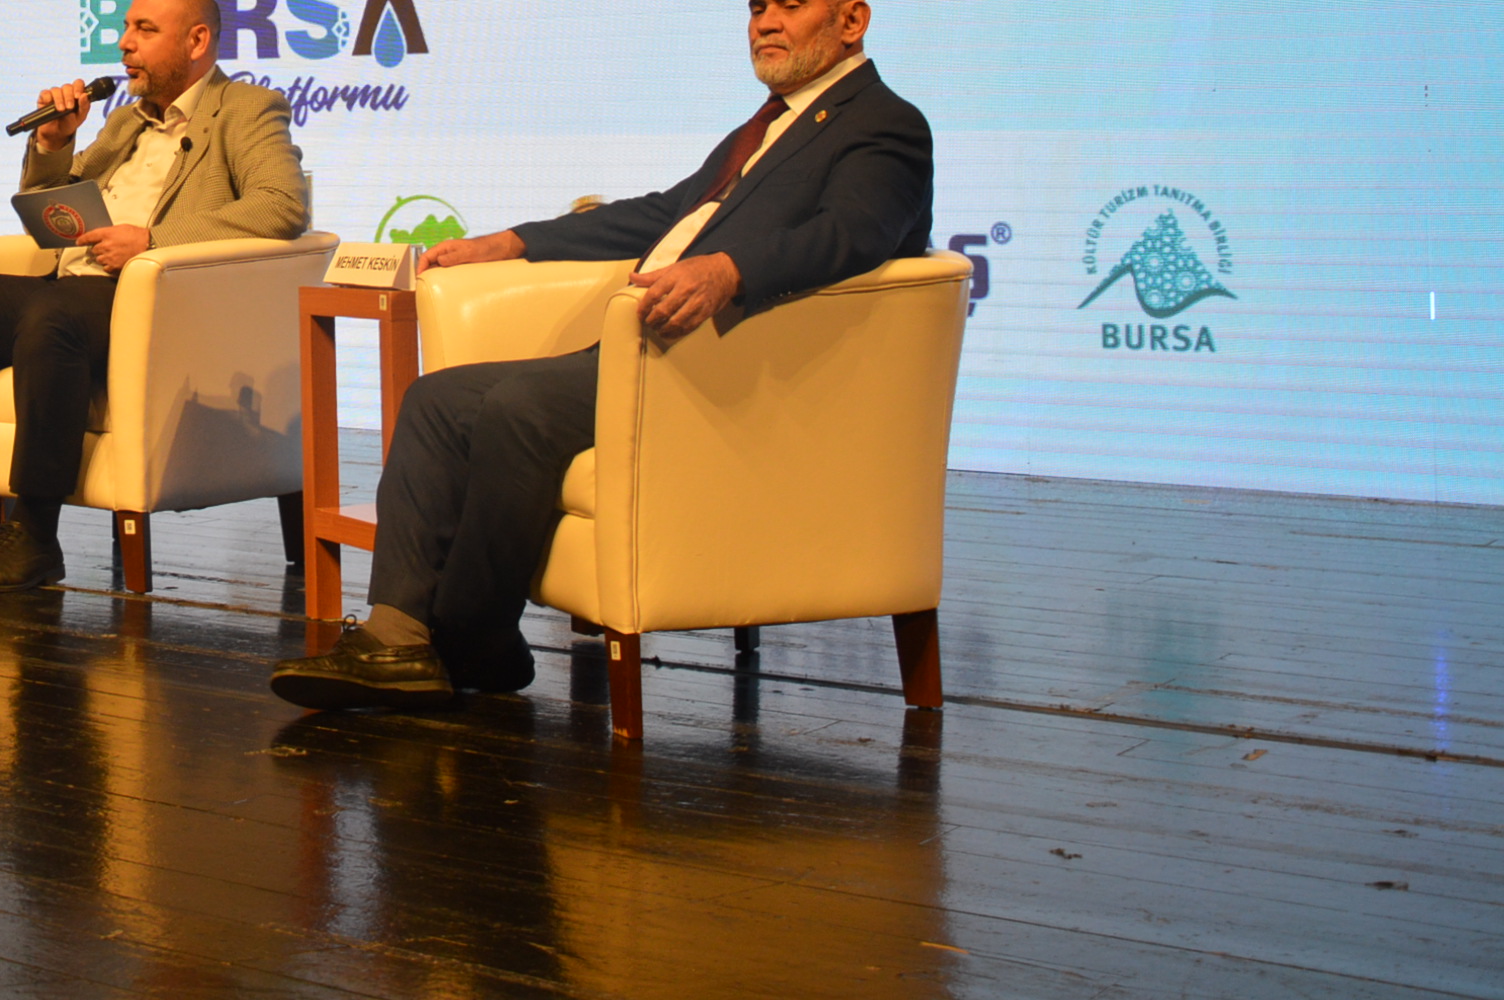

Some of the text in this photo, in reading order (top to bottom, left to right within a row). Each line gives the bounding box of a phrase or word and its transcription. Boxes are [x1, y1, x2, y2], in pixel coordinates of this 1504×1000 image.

[1098, 186, 1149, 219] TURİZM
[1152, 184, 1212, 222] TANITMA
[335, 254, 400, 271] MEHMET KESKİN
[1100, 322, 1217, 353] BURSA
